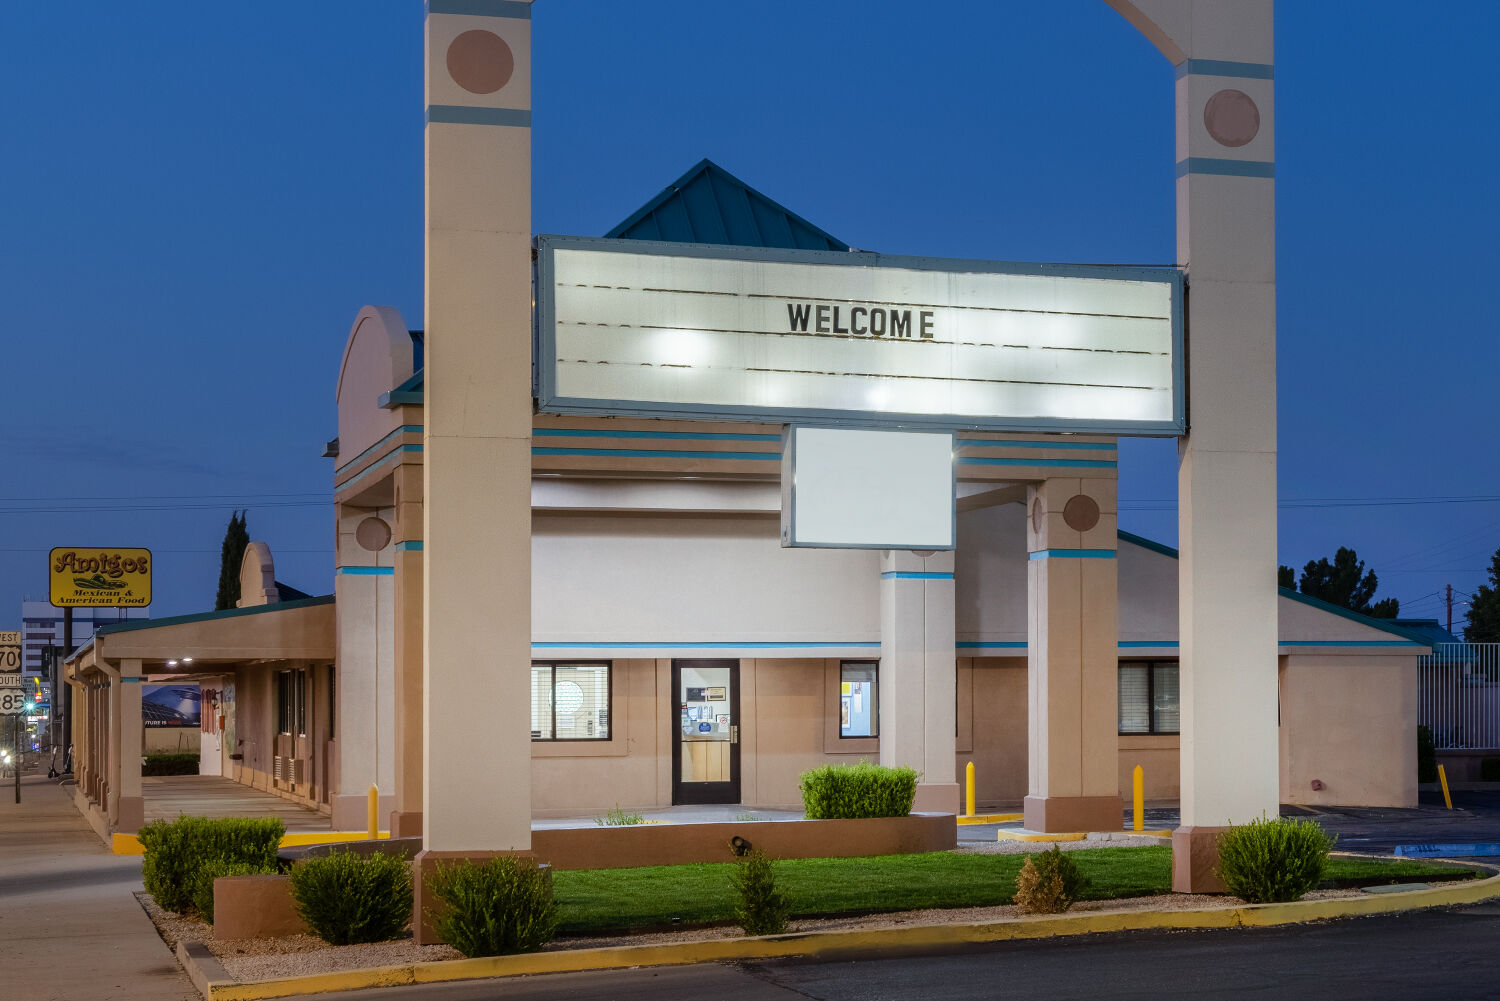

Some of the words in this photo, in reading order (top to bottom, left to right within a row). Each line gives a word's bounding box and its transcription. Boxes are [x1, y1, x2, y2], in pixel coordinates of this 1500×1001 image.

[786, 303, 934, 339] WELCOME
[54, 552, 148, 578] Amigos
[73, 589, 120, 597] Mexican
[124, 589, 134, 597] &
[0, 633, 17, 642] EST
[0, 695, 24, 710] 85
